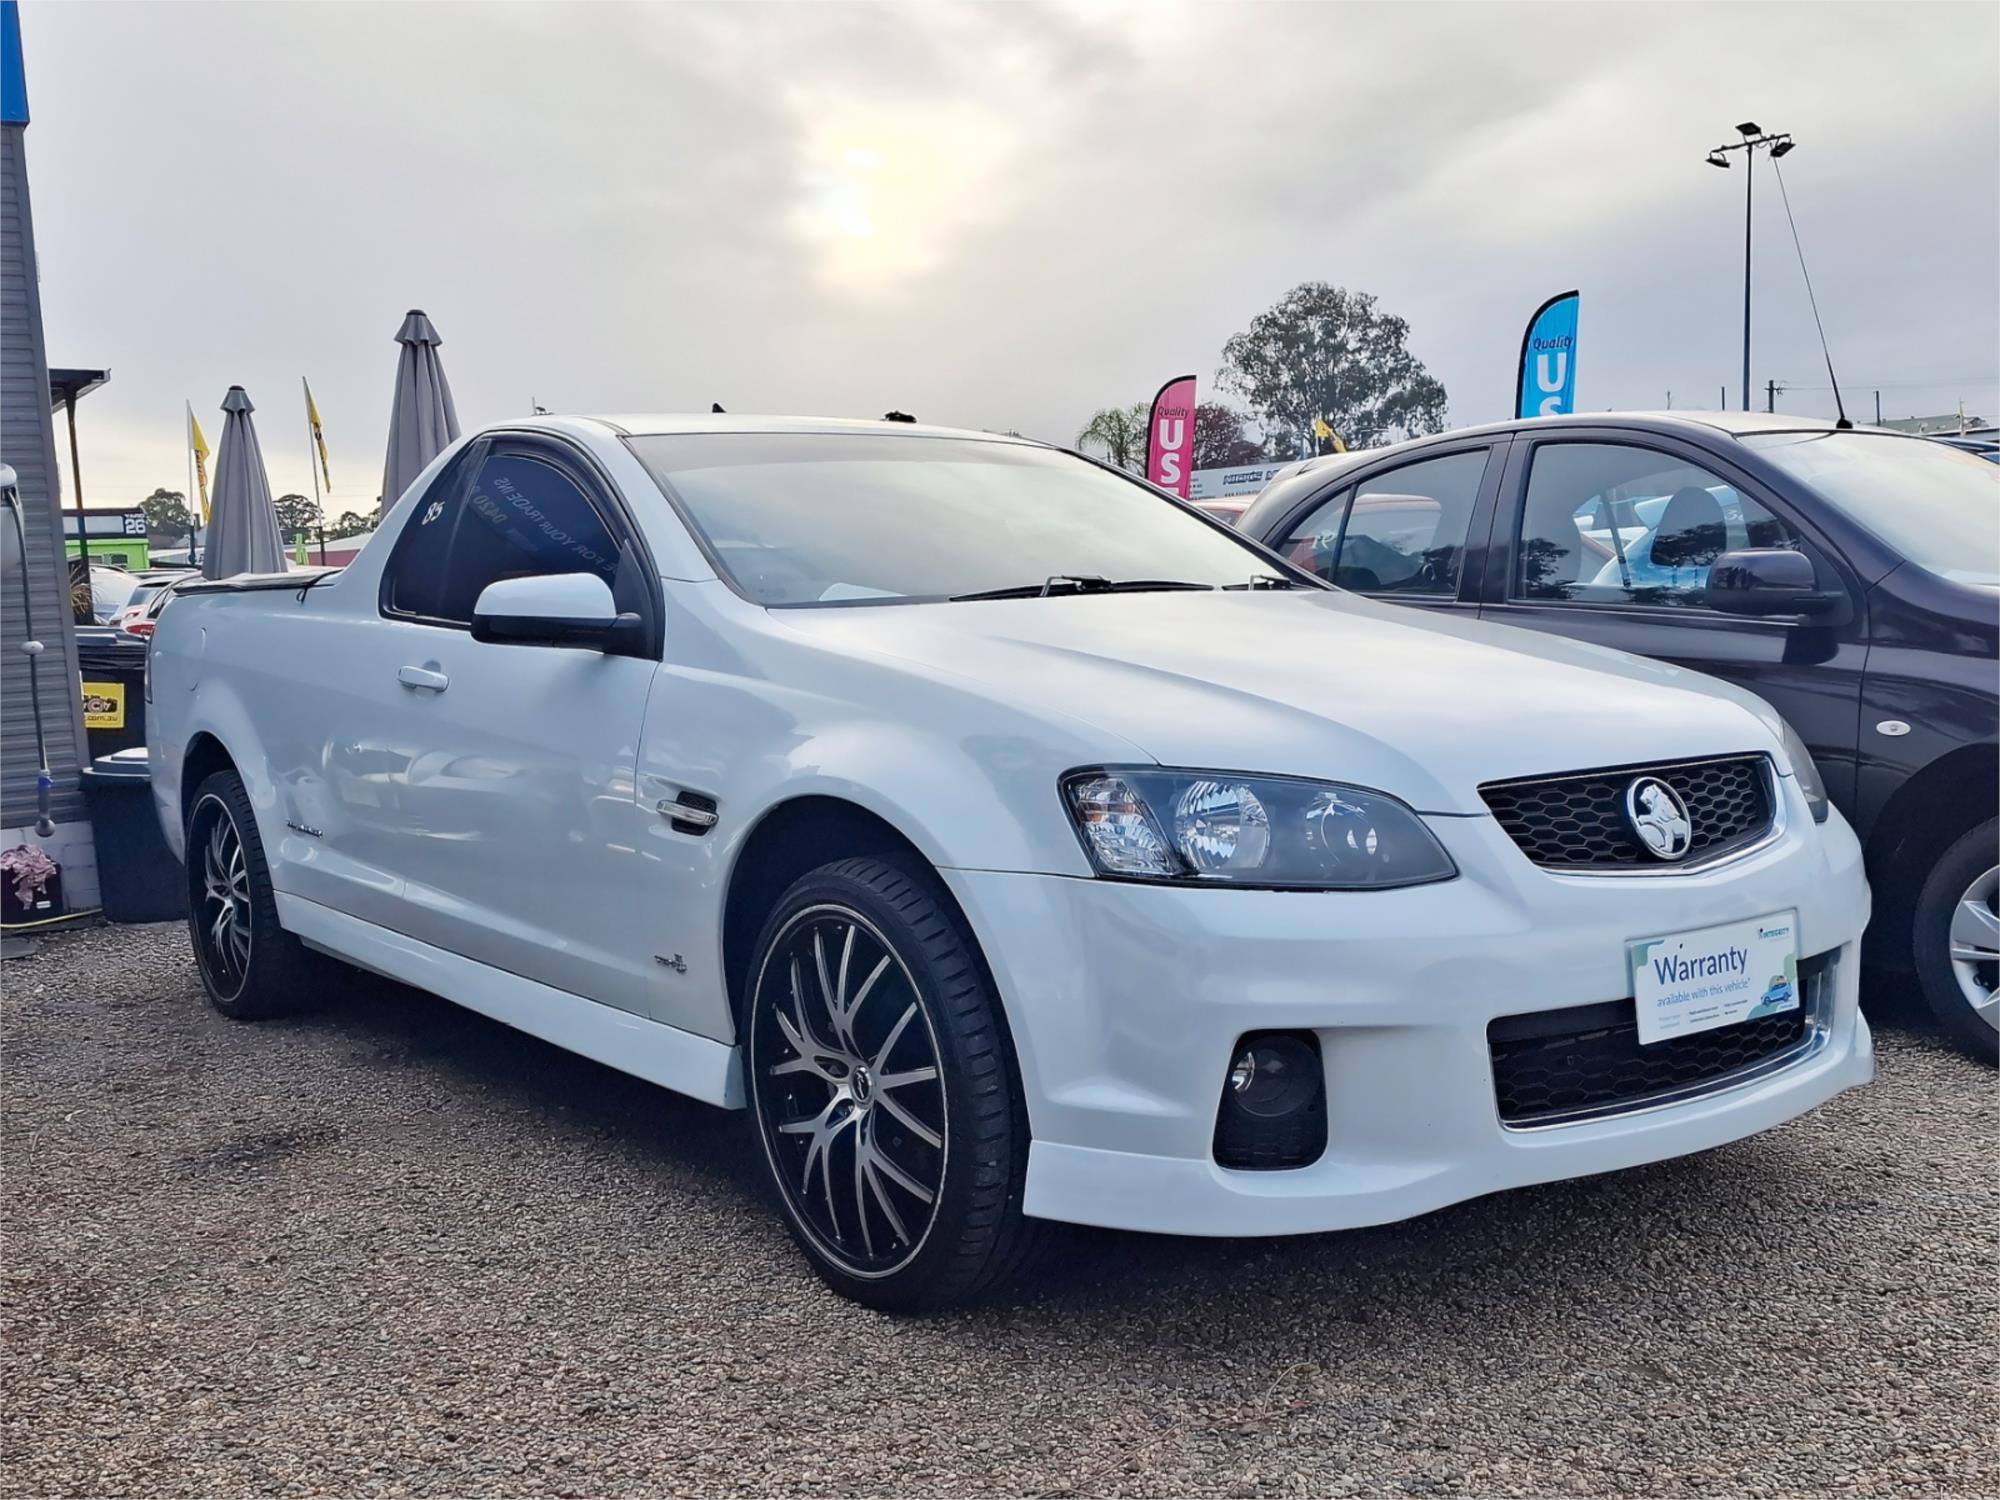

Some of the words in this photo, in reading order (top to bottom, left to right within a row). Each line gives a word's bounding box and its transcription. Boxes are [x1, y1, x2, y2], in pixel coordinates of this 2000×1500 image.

[1533, 336, 1573, 351] Quality
[1157, 406, 1190, 419] Quality
[125, 518, 147, 534] 26
[1653, 946, 1748, 985] Warranty
[1656, 991, 1691, 1007] available
[1691, 987, 1708, 1000] with
[1709, 984, 1724, 996] this
